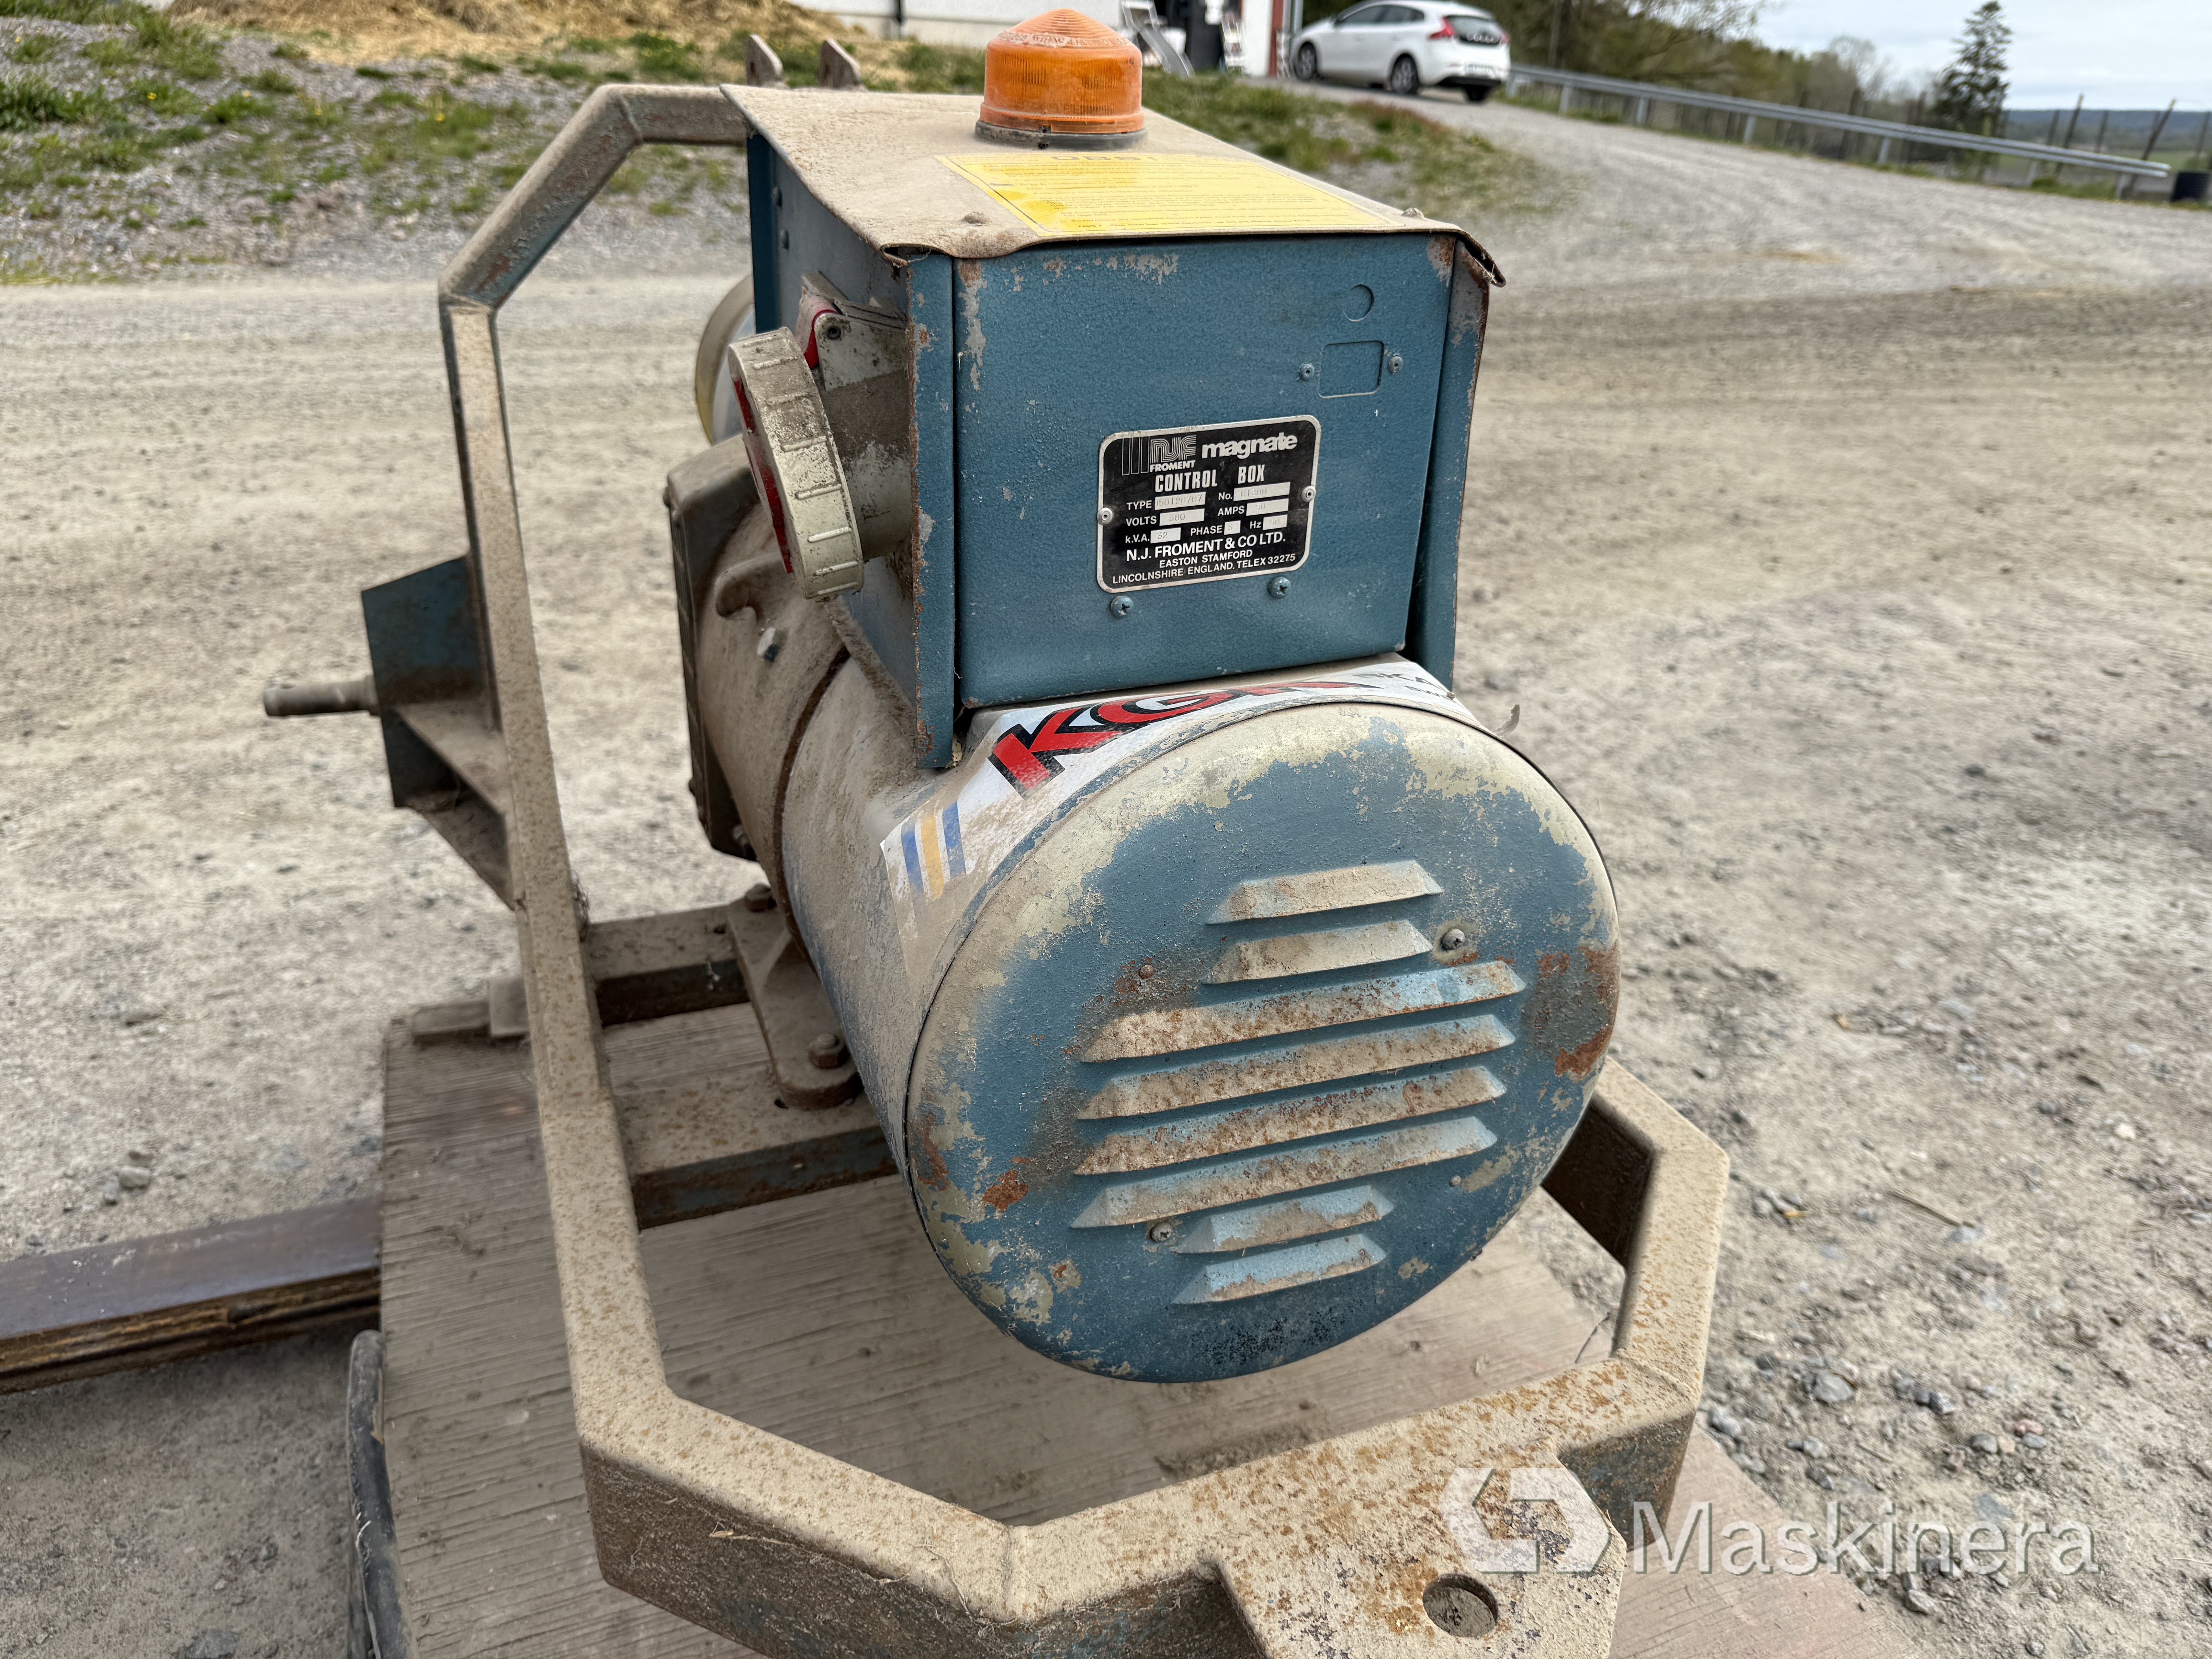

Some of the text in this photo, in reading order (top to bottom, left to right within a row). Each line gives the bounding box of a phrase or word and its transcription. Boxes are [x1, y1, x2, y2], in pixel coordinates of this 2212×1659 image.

[1202, 432, 1298, 459] magnate
[1150, 460, 1196, 472] FROMENT
[1155, 464, 1265, 493] CONTROL BOX
[1218, 492, 1233, 501] No.
[1126, 500, 1152, 511] TYPE
[1217, 505, 1245, 517] AMPS
[1126, 514, 1185, 527] VOLTS 380
[1249, 520, 1261, 529] Hz
[1190, 525, 1223, 536] PHASE
[1125, 533, 1150, 544] k.V.A.
[1126, 531, 1286, 562] N.J. FROMENT & CO LTD.
[1159, 549, 1253, 568] EASTON STAMFORD
[1113, 553, 1296, 584] LINCOLNSHIRE ENGLAND. TELEX 32275
